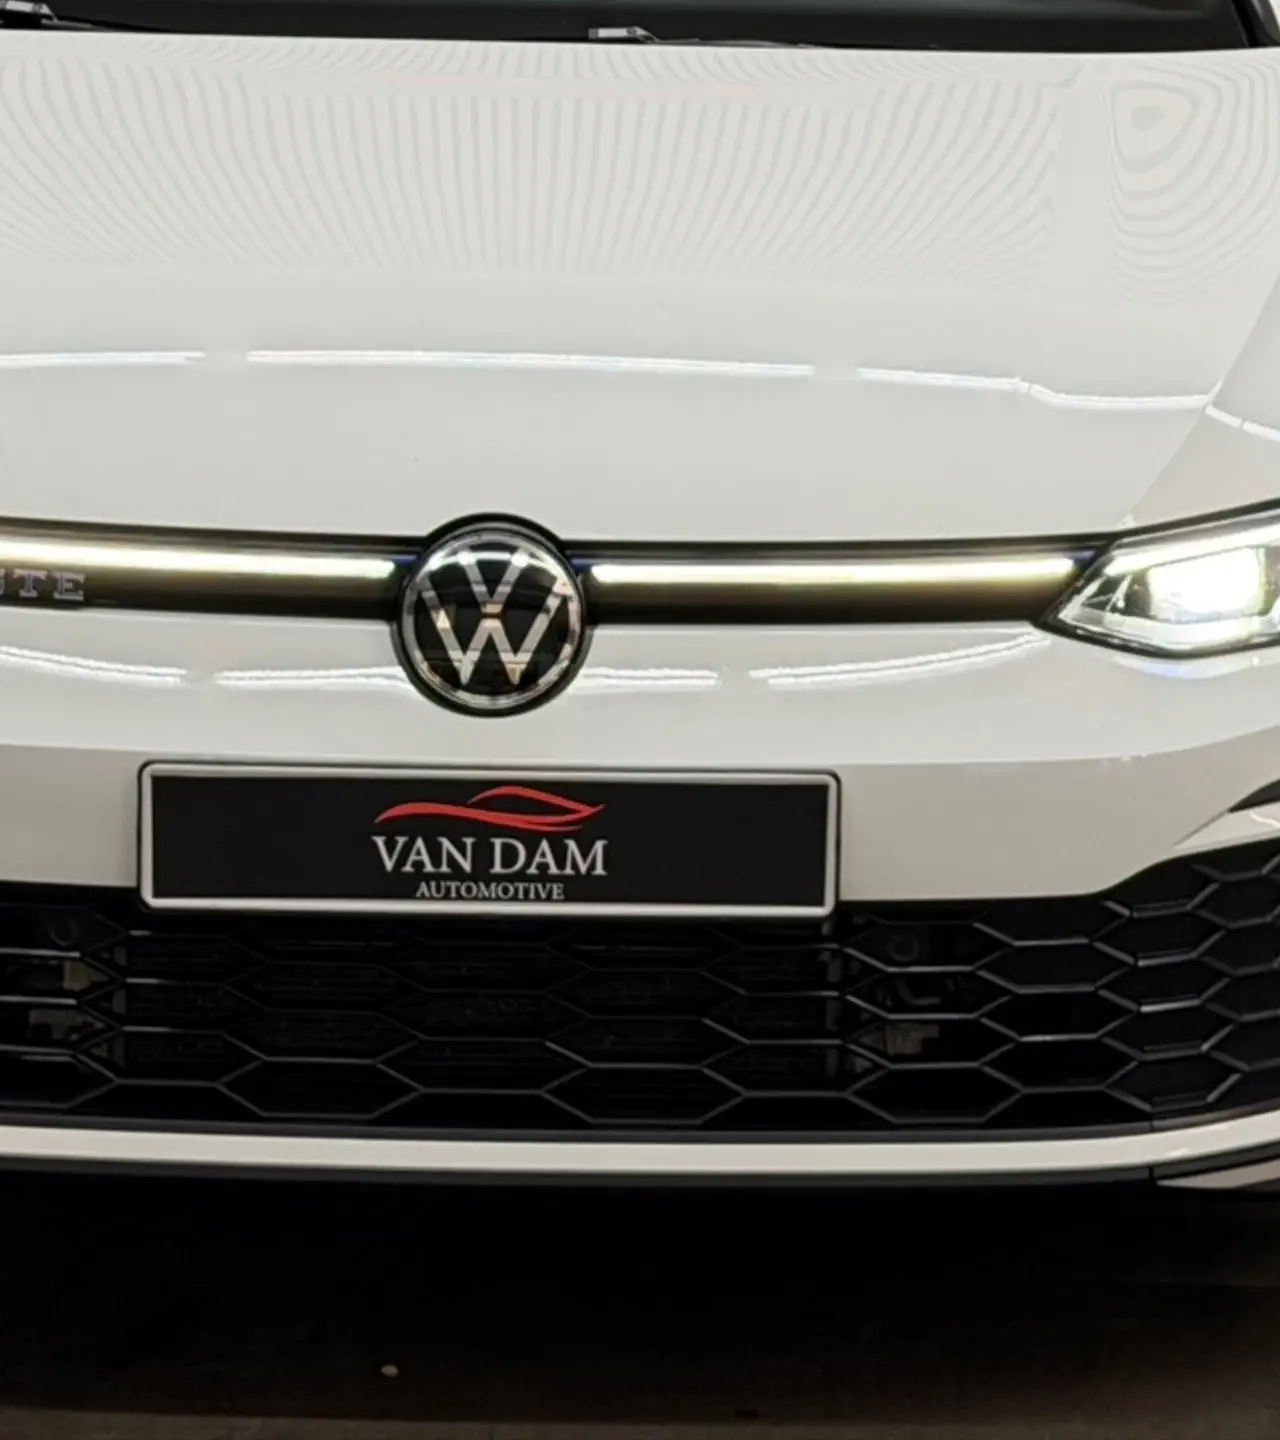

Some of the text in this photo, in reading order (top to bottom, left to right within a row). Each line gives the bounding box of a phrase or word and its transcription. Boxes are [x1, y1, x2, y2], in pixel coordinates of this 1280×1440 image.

[371, 835, 608, 876] VAN DAM
[415, 880, 564, 901] AUTOMOTIVE
